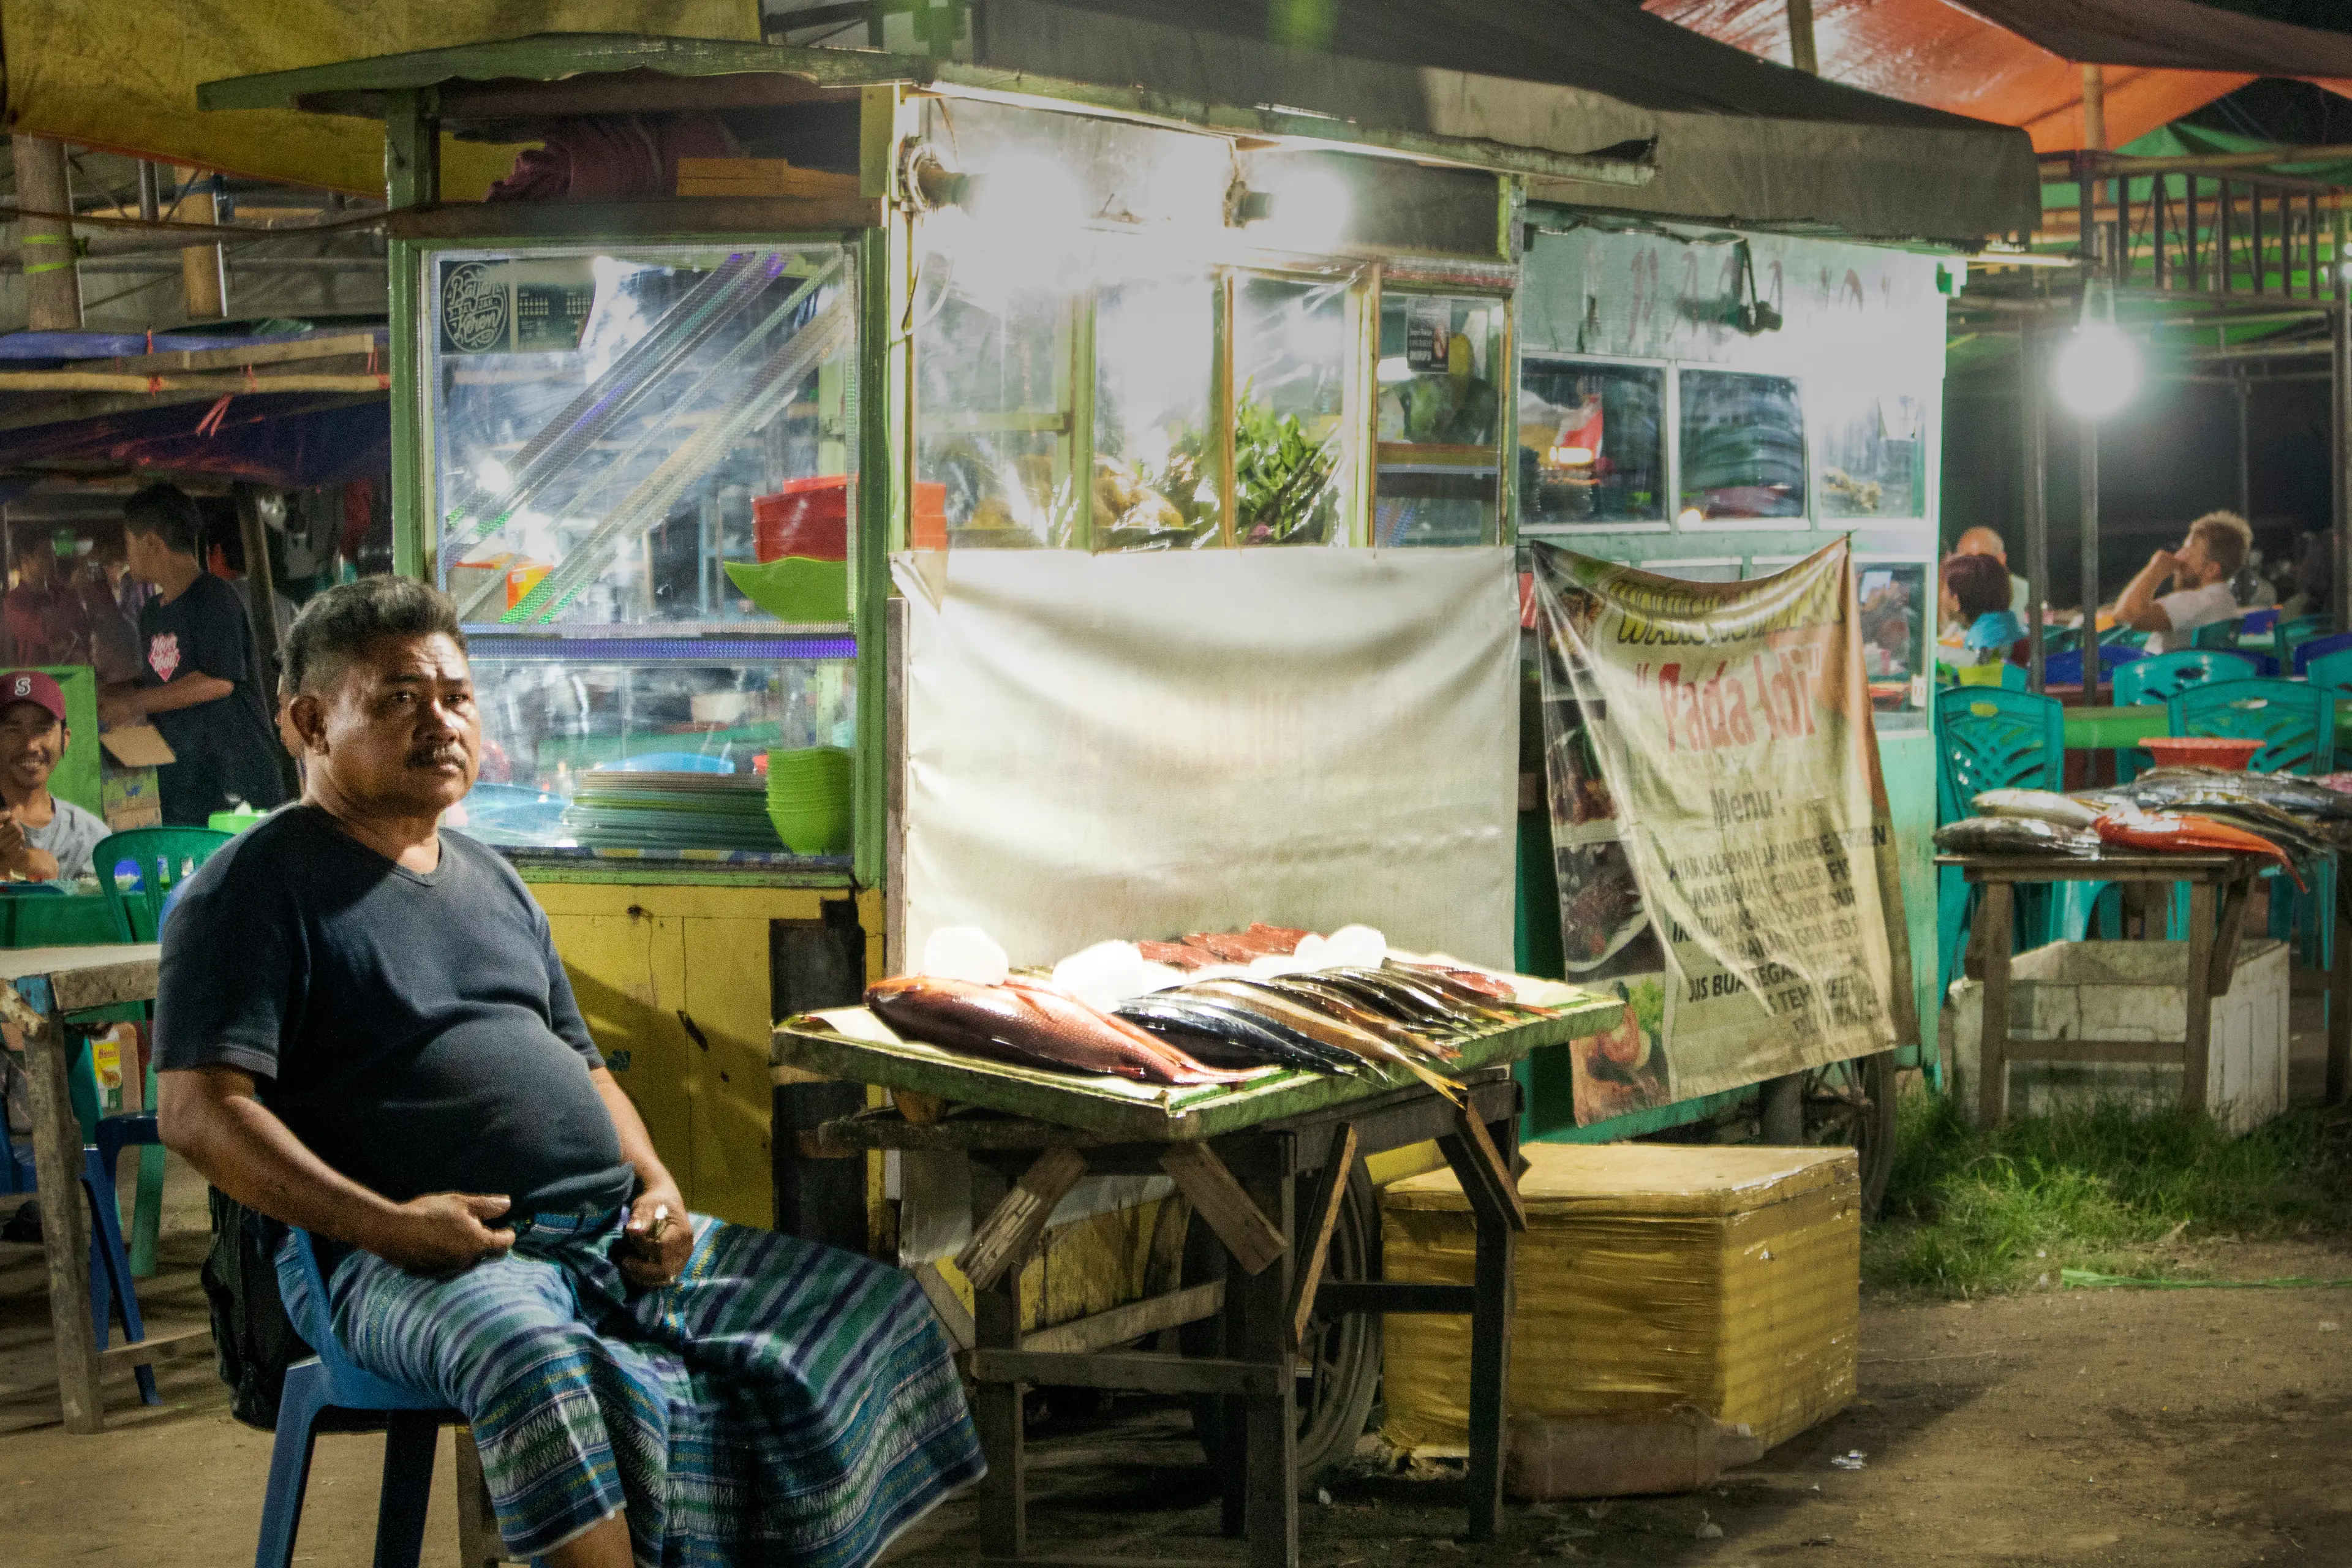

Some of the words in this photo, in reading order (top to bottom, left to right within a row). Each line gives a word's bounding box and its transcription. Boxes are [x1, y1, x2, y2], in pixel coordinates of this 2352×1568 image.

[14, 677, 31, 697] S
[1709, 788, 1774, 826] Menu
[1712, 968, 1750, 998] BUA
